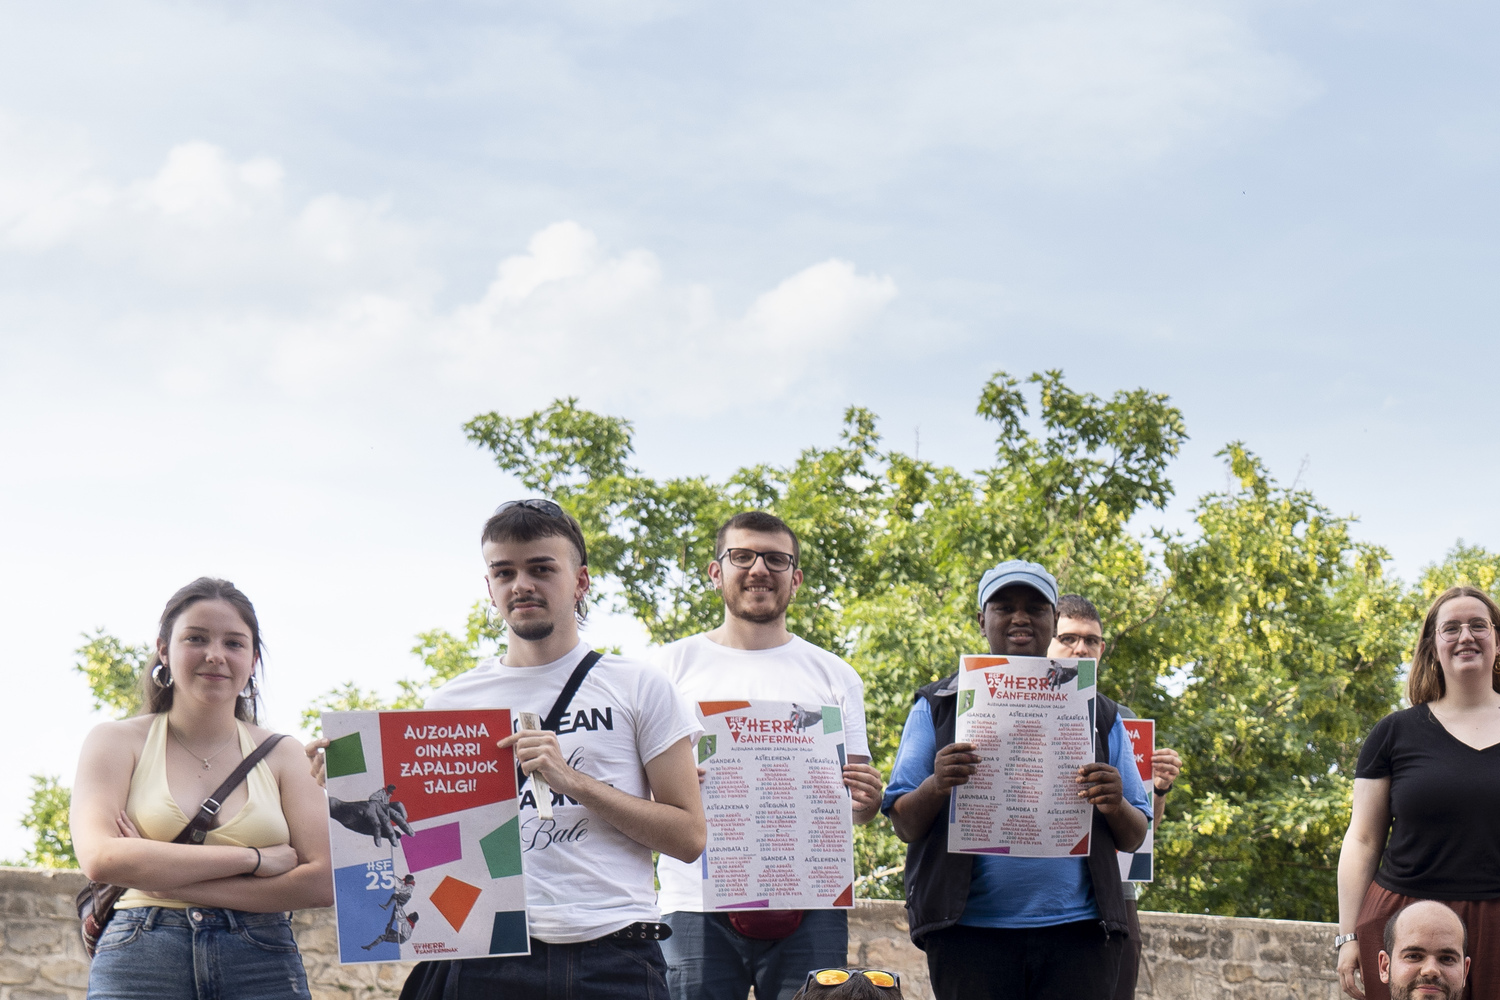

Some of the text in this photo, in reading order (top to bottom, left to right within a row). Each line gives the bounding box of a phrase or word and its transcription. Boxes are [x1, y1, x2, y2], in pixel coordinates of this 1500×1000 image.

[996, 691, 1068, 701] SANFERMINAK
[404, 723, 489, 739] AUZOLANA
[740, 734, 814, 744] SANFERMINAK
[416, 743, 480, 757] OINARRI
[401, 760, 498, 776] ZAPALDUOK
[425, 779, 476, 793] JALGI!
[366, 870, 395, 890] 25
